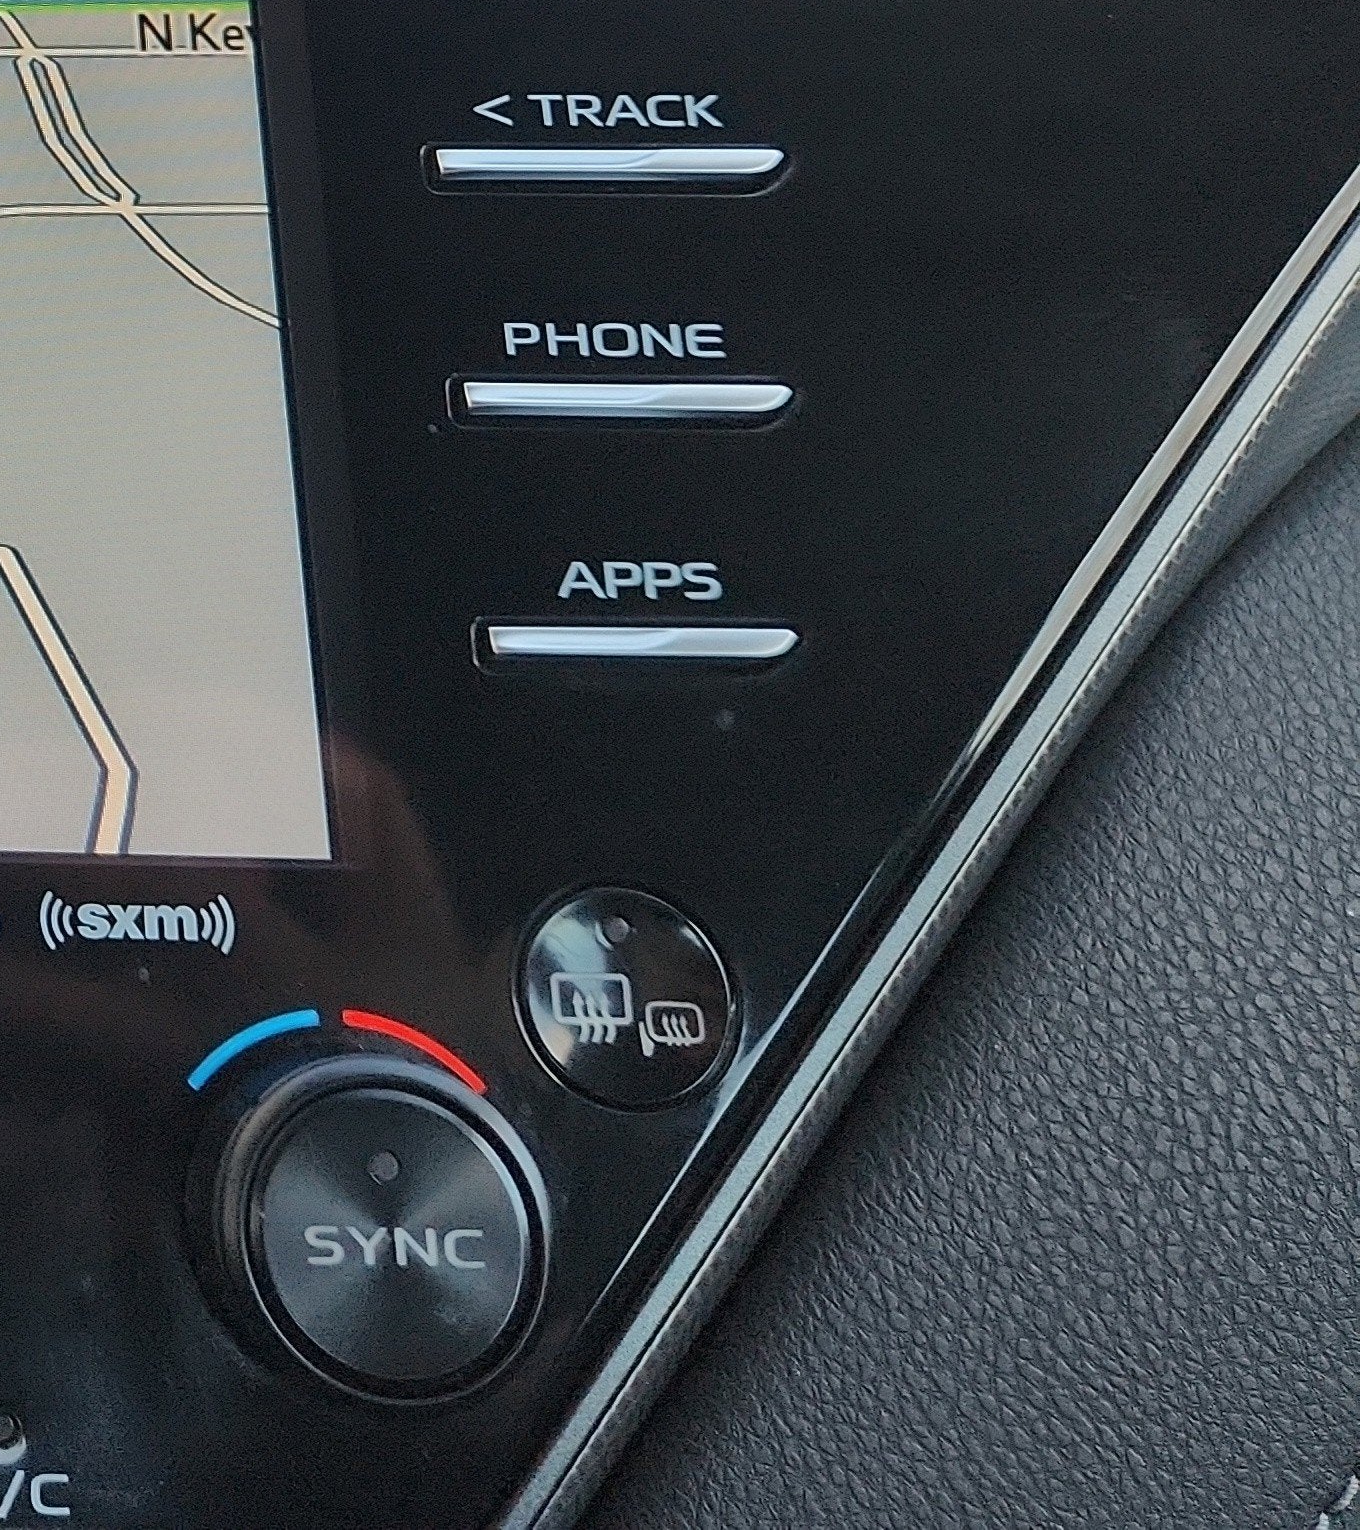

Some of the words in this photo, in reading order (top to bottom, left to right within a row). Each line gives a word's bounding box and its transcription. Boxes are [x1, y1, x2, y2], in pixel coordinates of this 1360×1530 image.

[137, 12, 173, 52] N
[527, 92, 724, 129] TRACK
[502, 320, 727, 360] PHONE
[557, 559, 723, 601] APPS
[302, 1223, 488, 1271] SYNC
